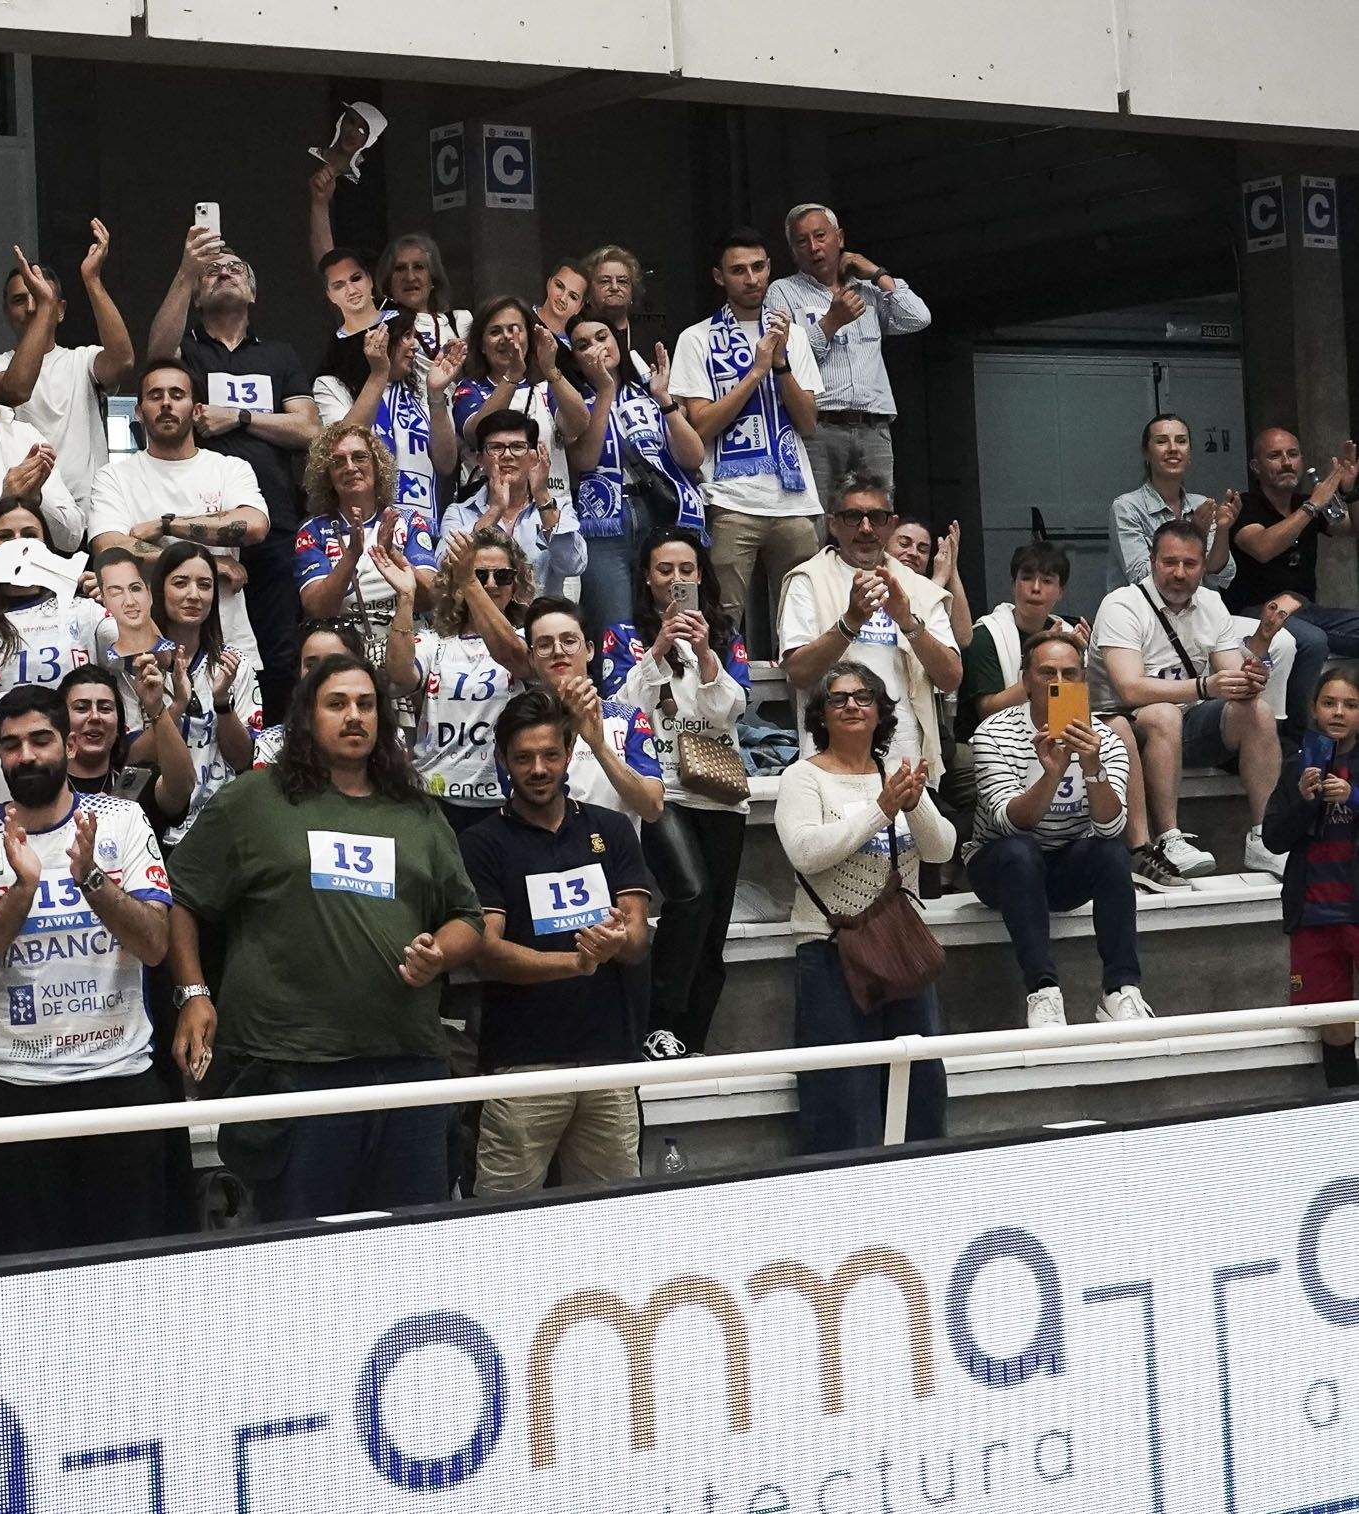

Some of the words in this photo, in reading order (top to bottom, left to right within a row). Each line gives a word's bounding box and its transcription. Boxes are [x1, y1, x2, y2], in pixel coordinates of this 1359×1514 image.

[436, 145, 459, 186] C
[492, 145, 524, 186] C
[1251, 195, 1277, 230] C
[1308, 194, 1330, 228] C
[1202, 326, 1229, 337] SALIDA
[226, 381, 258, 404] 13
[620, 405, 649, 430] 13
[13, 646, 62, 686] 13
[447, 668, 498, 702] 13
[437, 721, 497, 749] DIC
[448, 780, 498, 798] ence
[1057, 776, 1074, 799] 3
[1050, 804, 1072, 812] VIVA
[333, 842, 374, 874] 13
[37, 877, 81, 909] 13
[331, 877, 374, 893] JAVIVA
[548, 877, 590, 911] 13
[36, 915, 85, 930] JAVIVA
[553, 913, 596, 929] JAVIVA
[40, 979, 98, 1000] XUNTA
[42, 1000, 64, 1017] DE
[55, 1025, 125, 1047] DEPUTACIÓN
[355, 1224, 1066, 1493] omma
